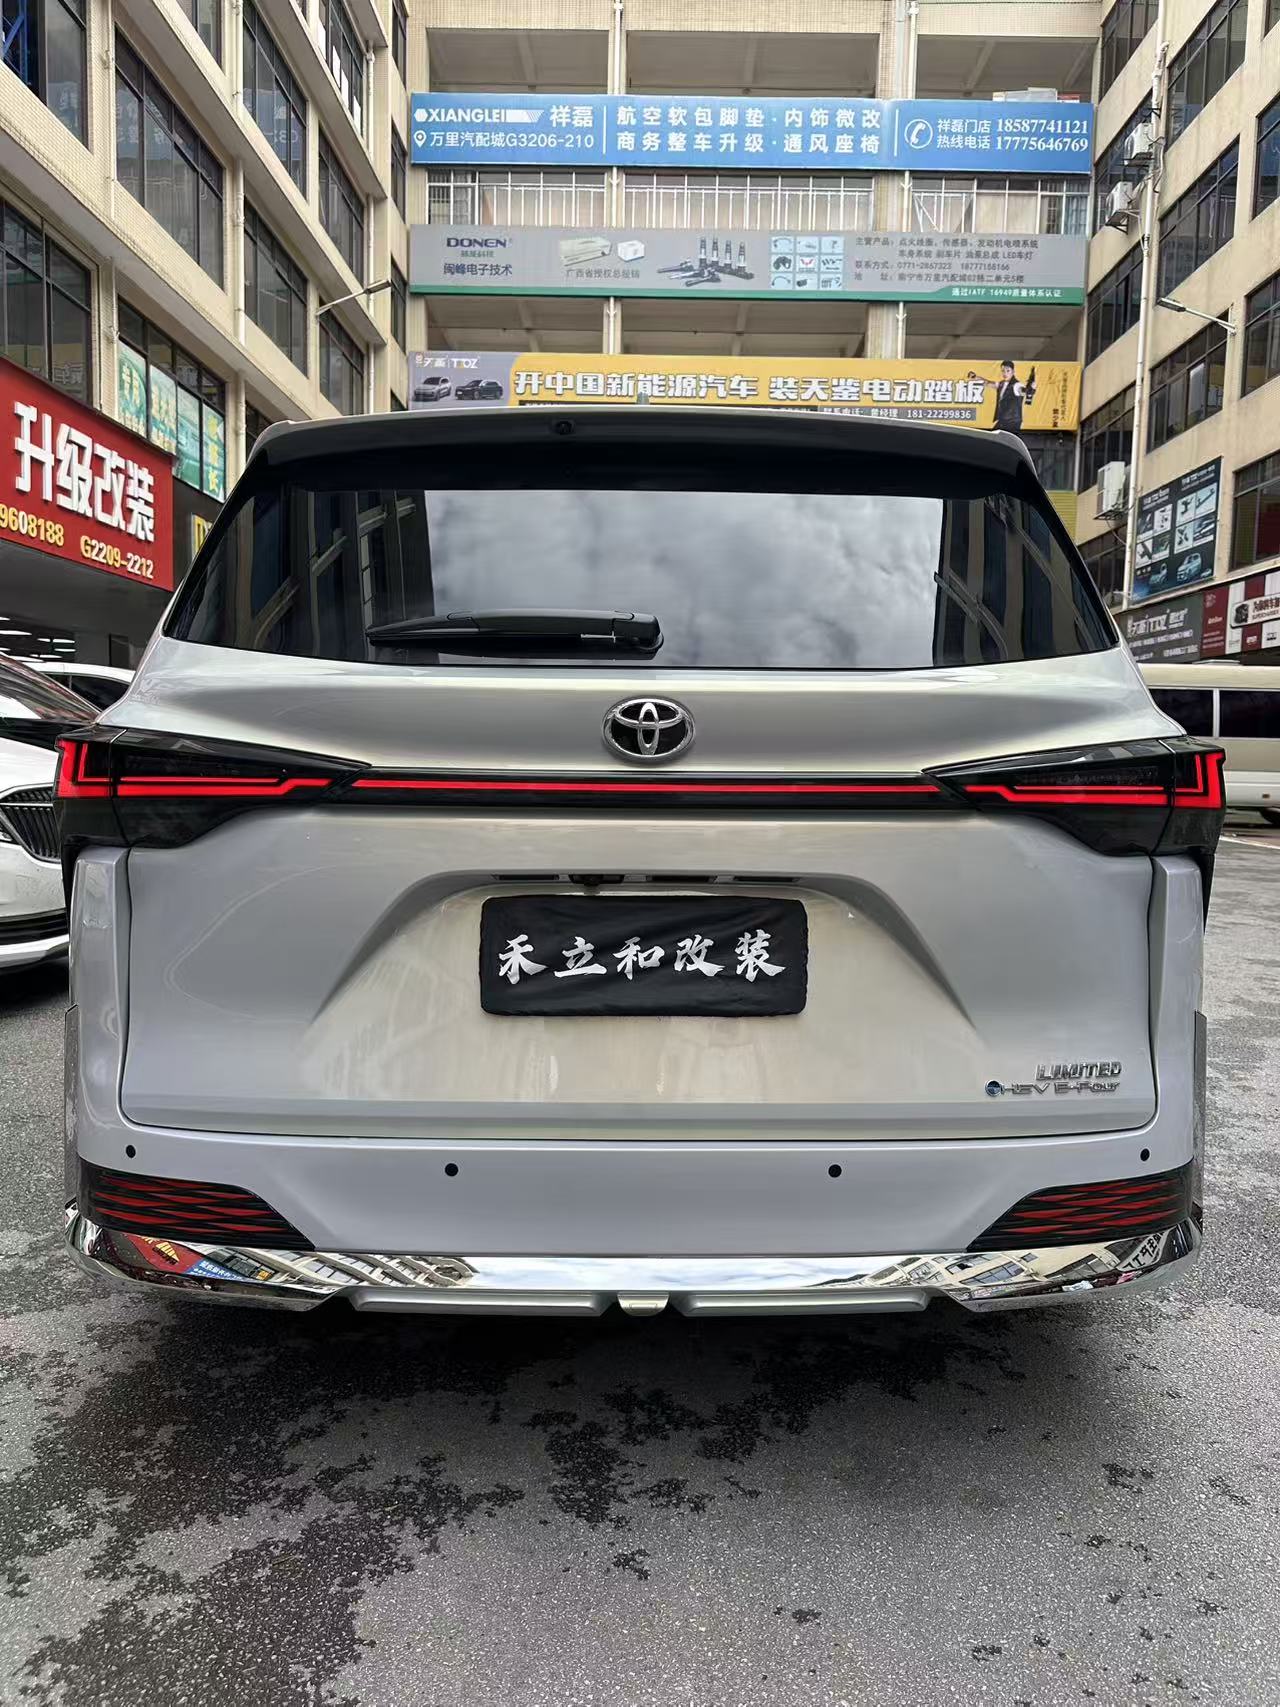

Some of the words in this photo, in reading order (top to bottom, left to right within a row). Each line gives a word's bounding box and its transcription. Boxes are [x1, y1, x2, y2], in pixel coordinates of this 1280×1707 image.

[425, 108, 507, 123] XIANGLEI
[550, 105, 593, 127] 祥磊
[937, 118, 991, 133] 祥磊门店
[996, 118, 1088, 135] 18587741121
[430, 132, 594, 148] 万里汽配城G3206-210
[937, 134, 991, 149] 热线电话
[996, 136, 1088, 152] 17775646769
[446, 237, 507, 248] DONEN
[514, 371, 758, 399] 开中国新能源汽车
[769, 375, 985, 404] 装天鉴电动踏板
[906, 409, 972, 419] 181-22299836
[14, 400, 155, 543] 升级改装
[80, 535, 154, 579] G2209-2212
[498, 929, 787, 985] 禾立和改装
[1035, 1061, 1122, 1081] LIMITED
